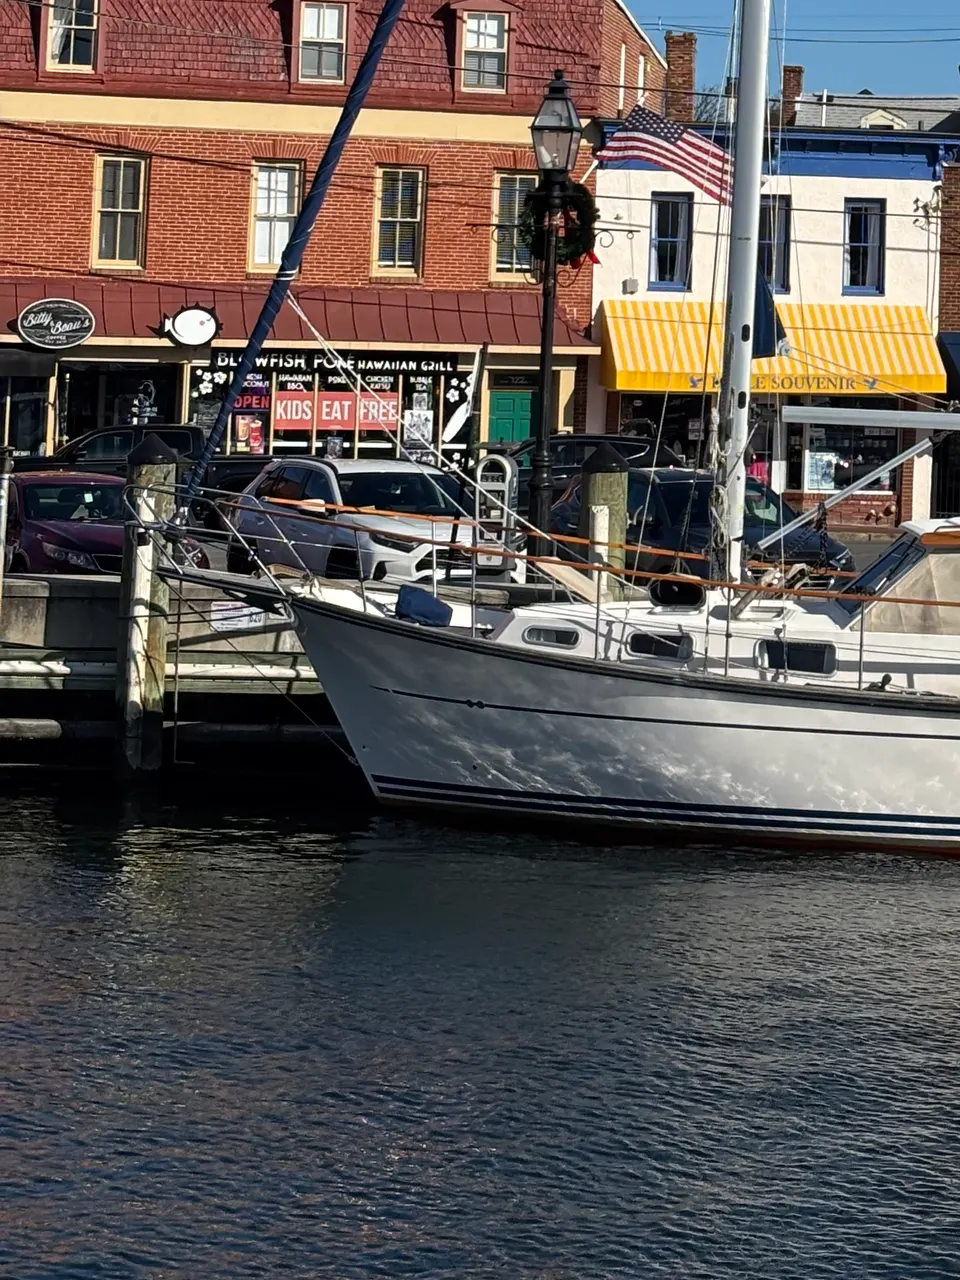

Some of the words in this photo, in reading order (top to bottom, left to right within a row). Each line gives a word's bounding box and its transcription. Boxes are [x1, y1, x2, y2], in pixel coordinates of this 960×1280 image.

[23, 311, 53, 327] Bitty
[51, 317, 91, 335] Beau's
[217, 352, 307, 368] BLWFISH
[358, 360, 417, 371] HAWAIIAN
[421, 361, 454, 371] GRILL
[771, 375, 856, 390] SOUVENIR
[234, 395, 270, 409] OPEN
[276, 400, 313, 420] KIDS
[321, 400, 352, 421] EAT
[360, 400, 398, 421] FREE
